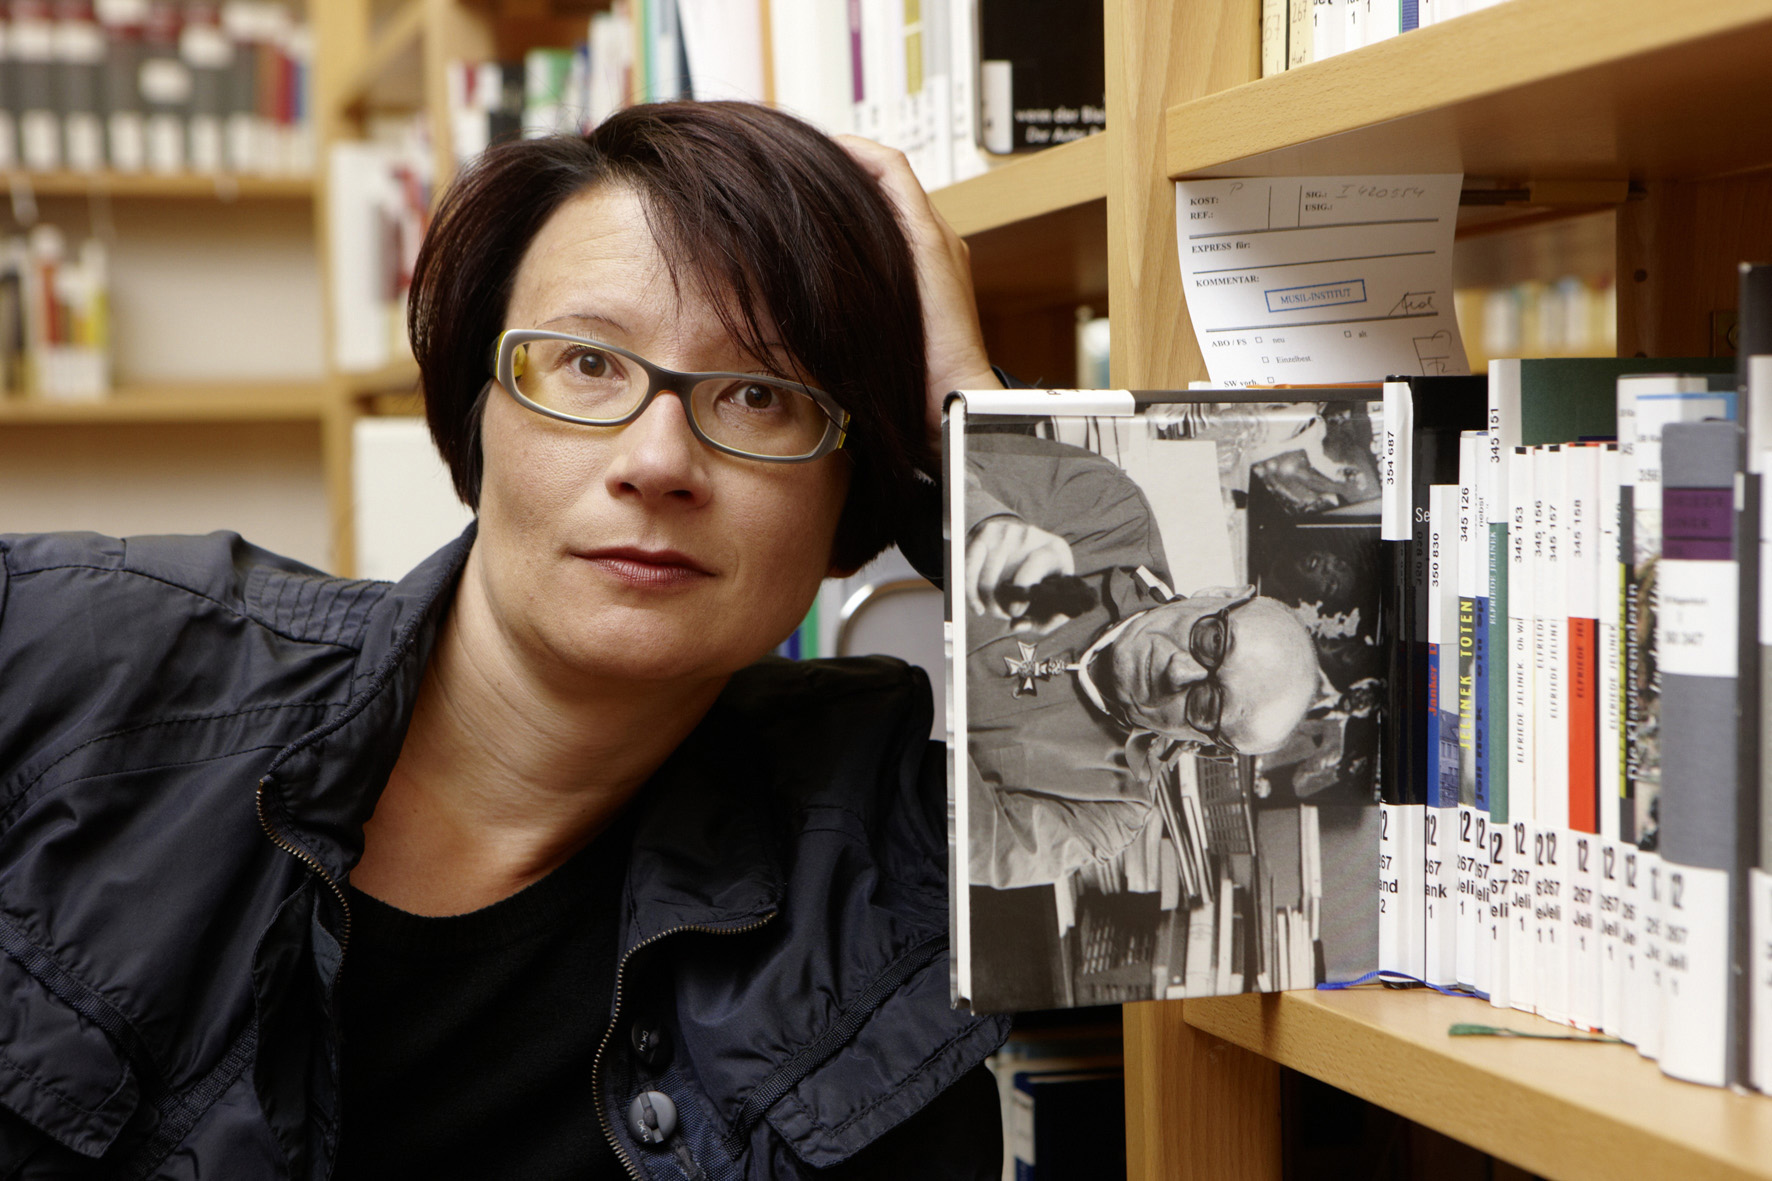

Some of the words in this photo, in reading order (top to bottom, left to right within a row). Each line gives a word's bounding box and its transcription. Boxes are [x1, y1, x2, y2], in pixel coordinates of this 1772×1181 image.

[1190, 197, 1219, 206] KOST:
[1190, 211, 1214, 220] REF.:
[1191, 242, 1232, 253] EXPRESS
[1236, 241, 1251, 250] für:
[1195, 275, 1260, 288] KOMMENTAR:
[1280, 288, 1351, 305] MUSIL-INSTITUT
[1272, 336, 1286, 345] neu
[1491, 408, 1499, 432] 151
[1491, 438, 1499, 463] 345
[1461, 488, 1469, 511] 126
[1515, 507, 1523, 531] 153
[1461, 601, 1473, 657] TOTEN
[1428, 665, 1437, 716] Janker
[1460, 675, 1471, 750] JELINEK
[1426, 815, 1436, 846] 12
[1459, 811, 1471, 842] 12
[1476, 818, 1486, 849] 12
[1514, 822, 1525, 855] 12
[1490, 832, 1503, 864] 12
[1546, 832, 1556, 866] 12
[1577, 839, 1588, 873] 12
[1602, 847, 1614, 880] 12
[1512, 868, 1529, 885] 267
[1380, 899, 1386, 913] 2
[1460, 901, 1464, 915] 1
[1512, 892, 1531, 909] Jeli
[1429, 904, 1433, 918] 1
[1478, 909, 1482, 923] 1
[1520, 916, 1524, 931] 1
[1492, 925, 1496, 940] 1
[1538, 927, 1542, 943] 1
[1550, 927, 1554, 943] 1
[1580, 935, 1585, 951] 1
